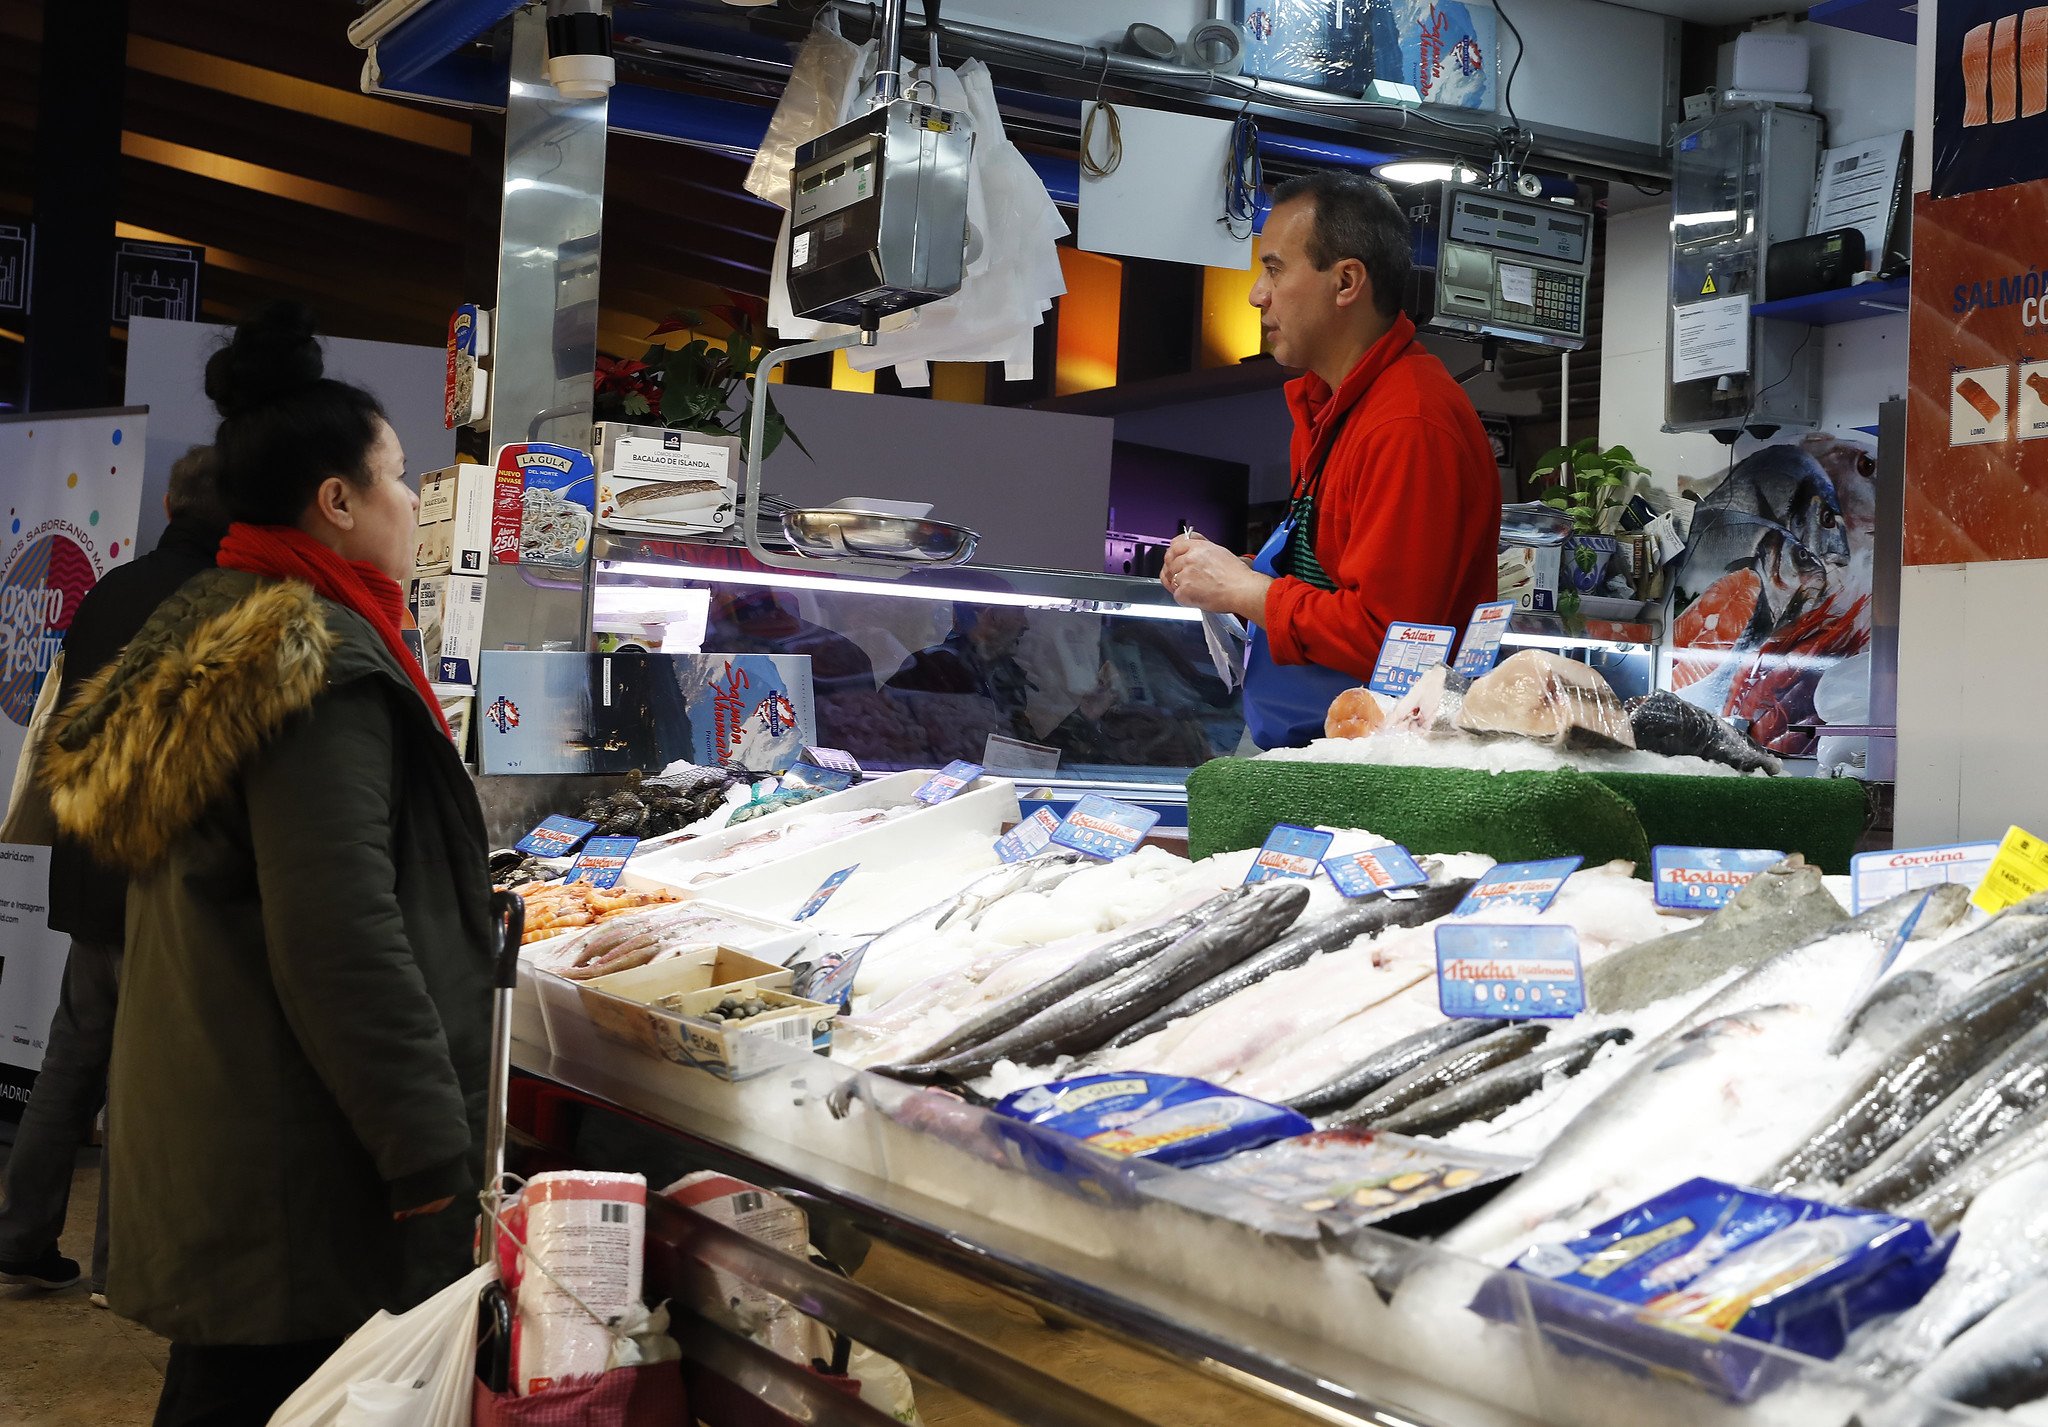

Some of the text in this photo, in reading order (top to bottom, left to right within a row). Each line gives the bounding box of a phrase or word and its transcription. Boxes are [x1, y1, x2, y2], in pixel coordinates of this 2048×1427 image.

[522, 455, 566, 469] LA GULA
[632, 454, 711, 469] BACALAO DE ISLANDIA
[497, 470, 520, 479] NUEVO
[497, 477, 521, 485] ENVASE
[26, 518, 94, 552] SABOREANDO
[493, 534, 519, 552] 250g
[725, 660, 749, 744] Salmón
[708, 682, 732, 766] Ahumado
[1888, 849, 1965, 868] Corvina
[1667, 867, 1753, 886] Rodaba
[1445, 958, 1516, 980] Trucha
